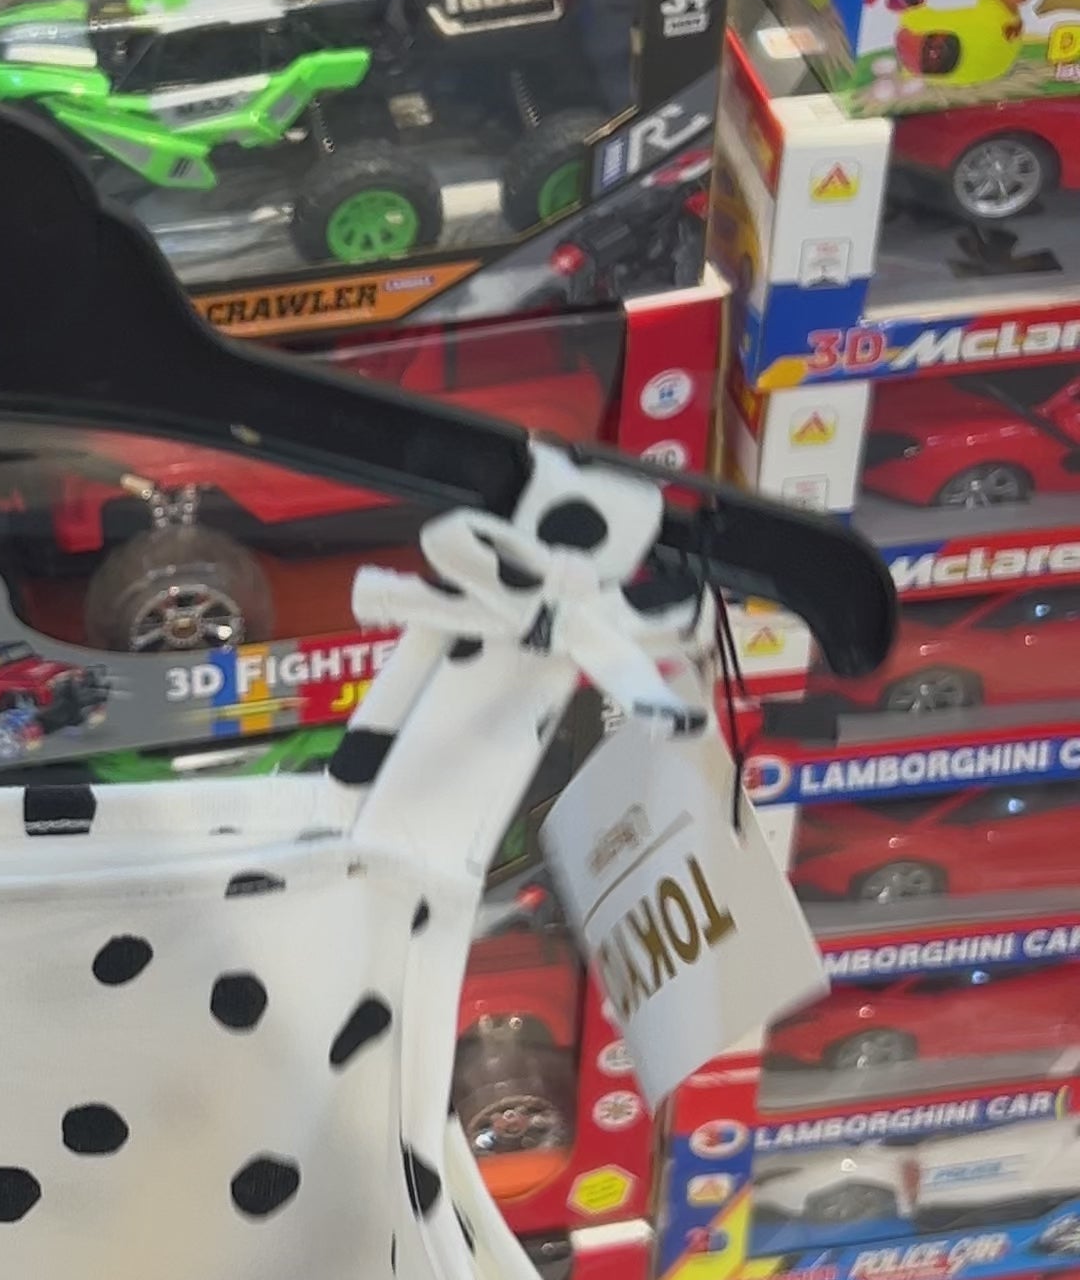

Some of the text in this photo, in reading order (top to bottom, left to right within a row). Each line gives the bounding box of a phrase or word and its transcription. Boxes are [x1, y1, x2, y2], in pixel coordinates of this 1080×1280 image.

[206, 282, 379, 326] CRAWLER
[807, 325, 888, 374] 3D
[166, 663, 224, 702] 3D
[799, 738, 1051, 796] LAMBORGHINI
[823, 931, 1016, 977] MBORGHINI
[754, 1091, 1054, 1149] LAMBORGHINI CAR
